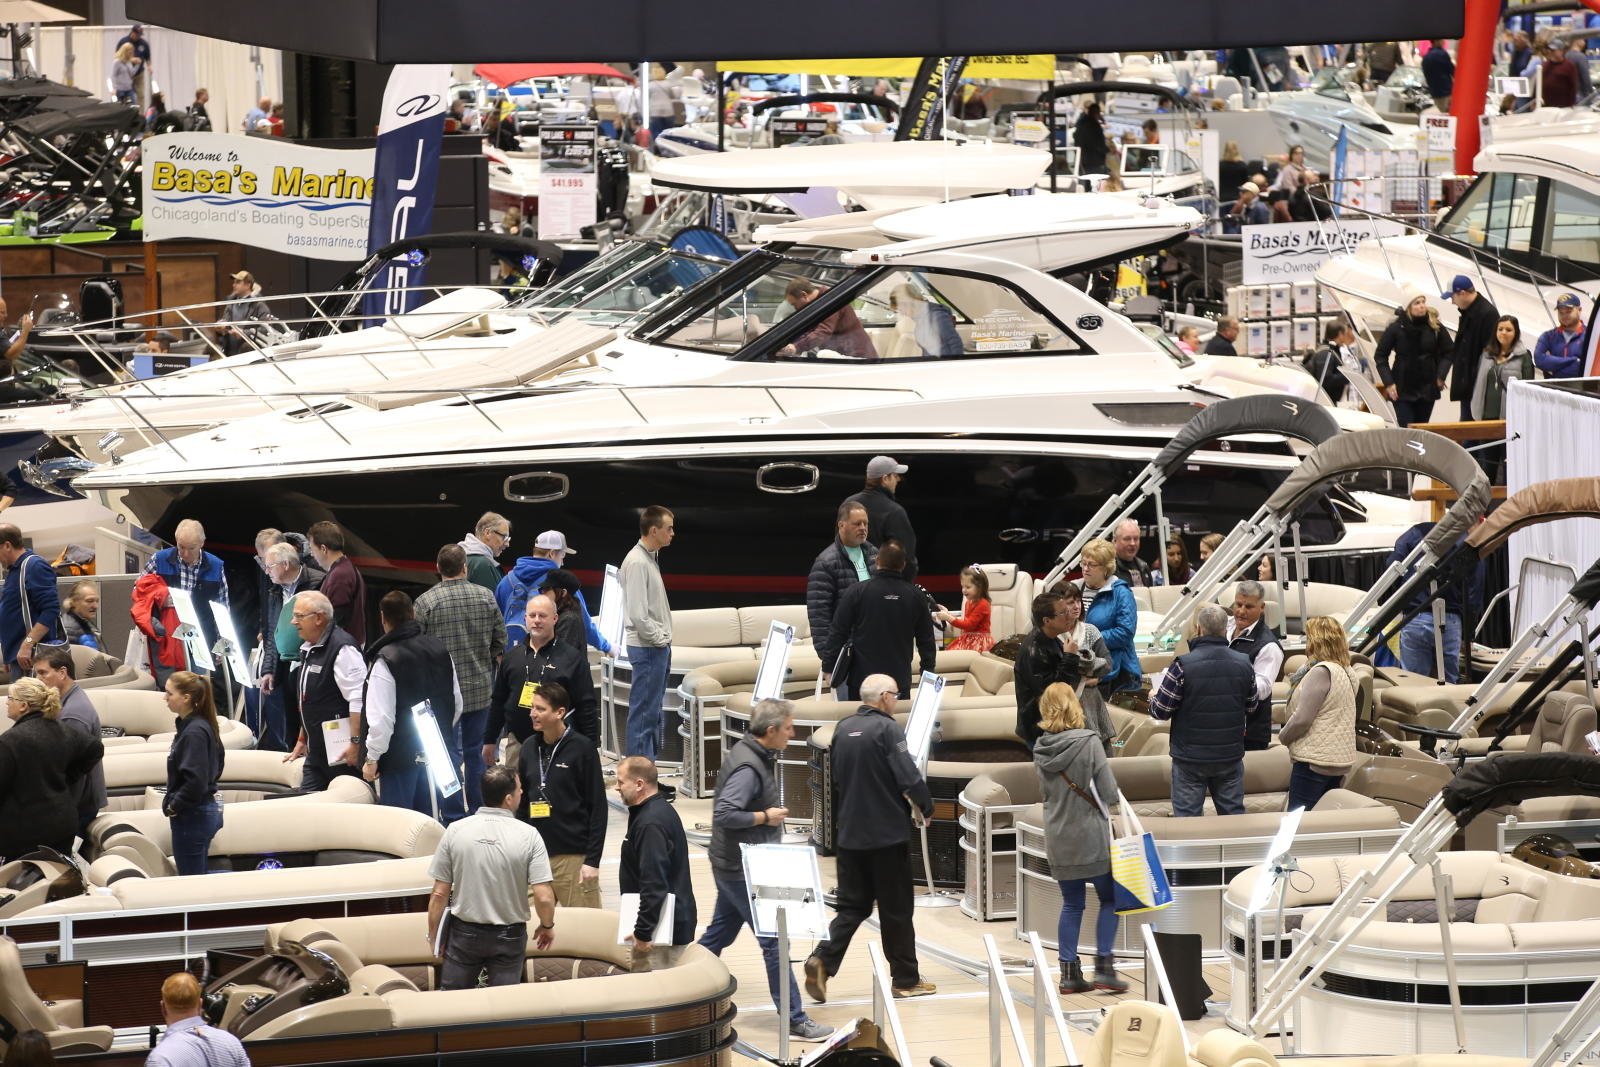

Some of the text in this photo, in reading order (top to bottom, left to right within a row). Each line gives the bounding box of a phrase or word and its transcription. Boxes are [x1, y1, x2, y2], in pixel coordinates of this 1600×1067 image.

[1427, 118, 1448, 128] FREE
[168, 144, 239, 162] Welcome to
[151, 161, 258, 195] Basa's
[151, 206, 370, 230] Chicagoland's Boating SuperSto
[287, 233, 369, 249] basasmarine.co
[1250, 228, 1370, 250] Basa's Marine
[1262, 260, 1321, 275] Pre-Owned
[1081, 317, 1099, 328] 35
